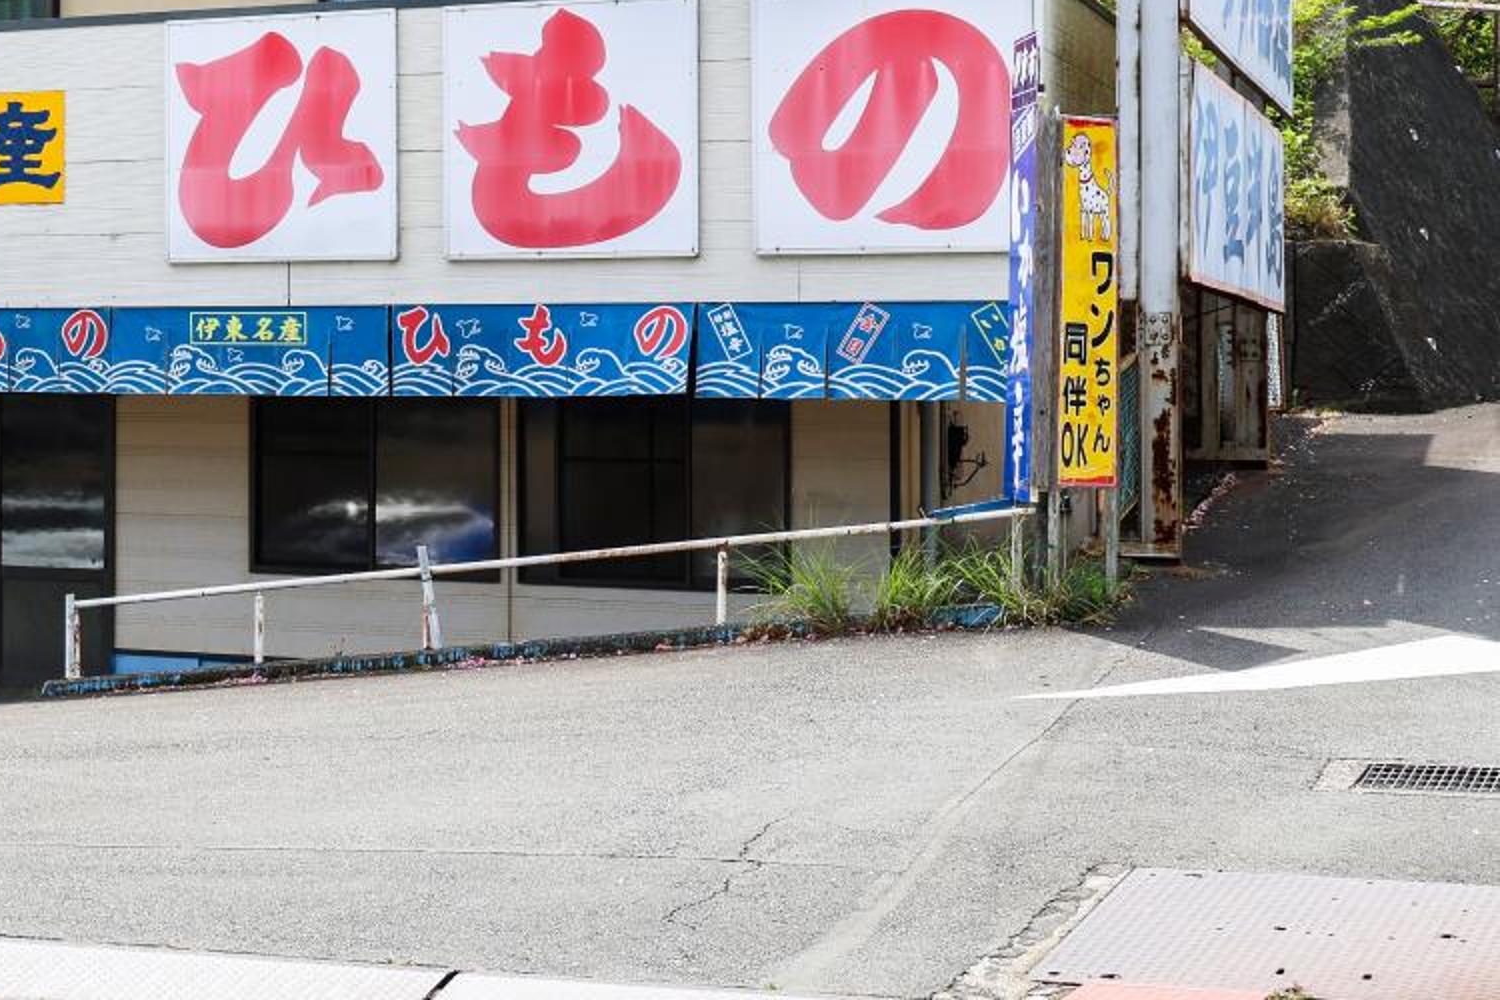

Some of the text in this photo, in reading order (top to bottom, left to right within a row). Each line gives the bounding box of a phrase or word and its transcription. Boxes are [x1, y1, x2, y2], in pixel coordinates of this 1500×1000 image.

[175, 7, 1013, 248] ひもの
[195, 316, 302, 342] 伊東名産
[397, 305, 688, 366] ひもの
[1061, 322, 1089, 469] 同伴OK
[1090, 251, 1113, 453] ワンちゃん
